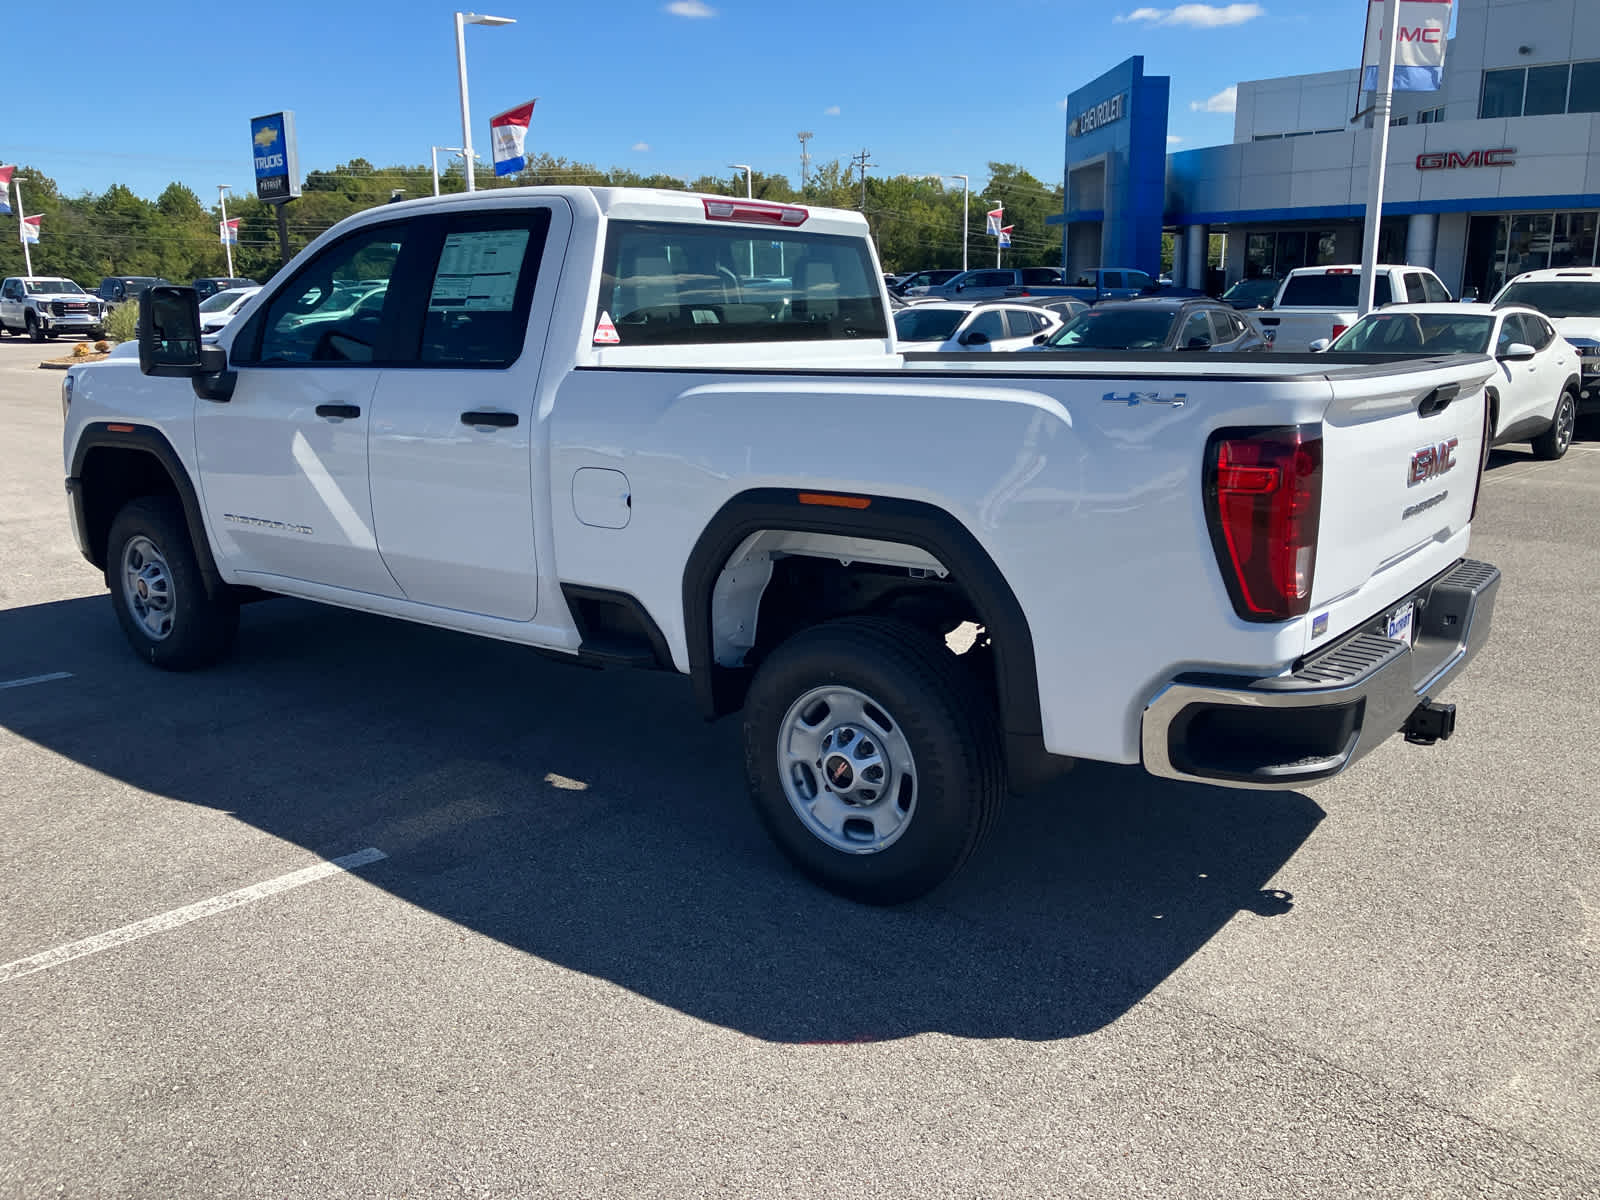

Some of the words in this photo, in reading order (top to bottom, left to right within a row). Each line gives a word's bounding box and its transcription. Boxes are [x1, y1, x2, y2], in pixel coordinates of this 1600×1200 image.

[1379, 26, 1441, 43] MC
[1080, 94, 1123, 134] CHEVROLET
[255, 154, 283, 169] TRUCKS
[1416, 147, 1517, 170] GMC
[1406, 437, 1458, 488] GMC
